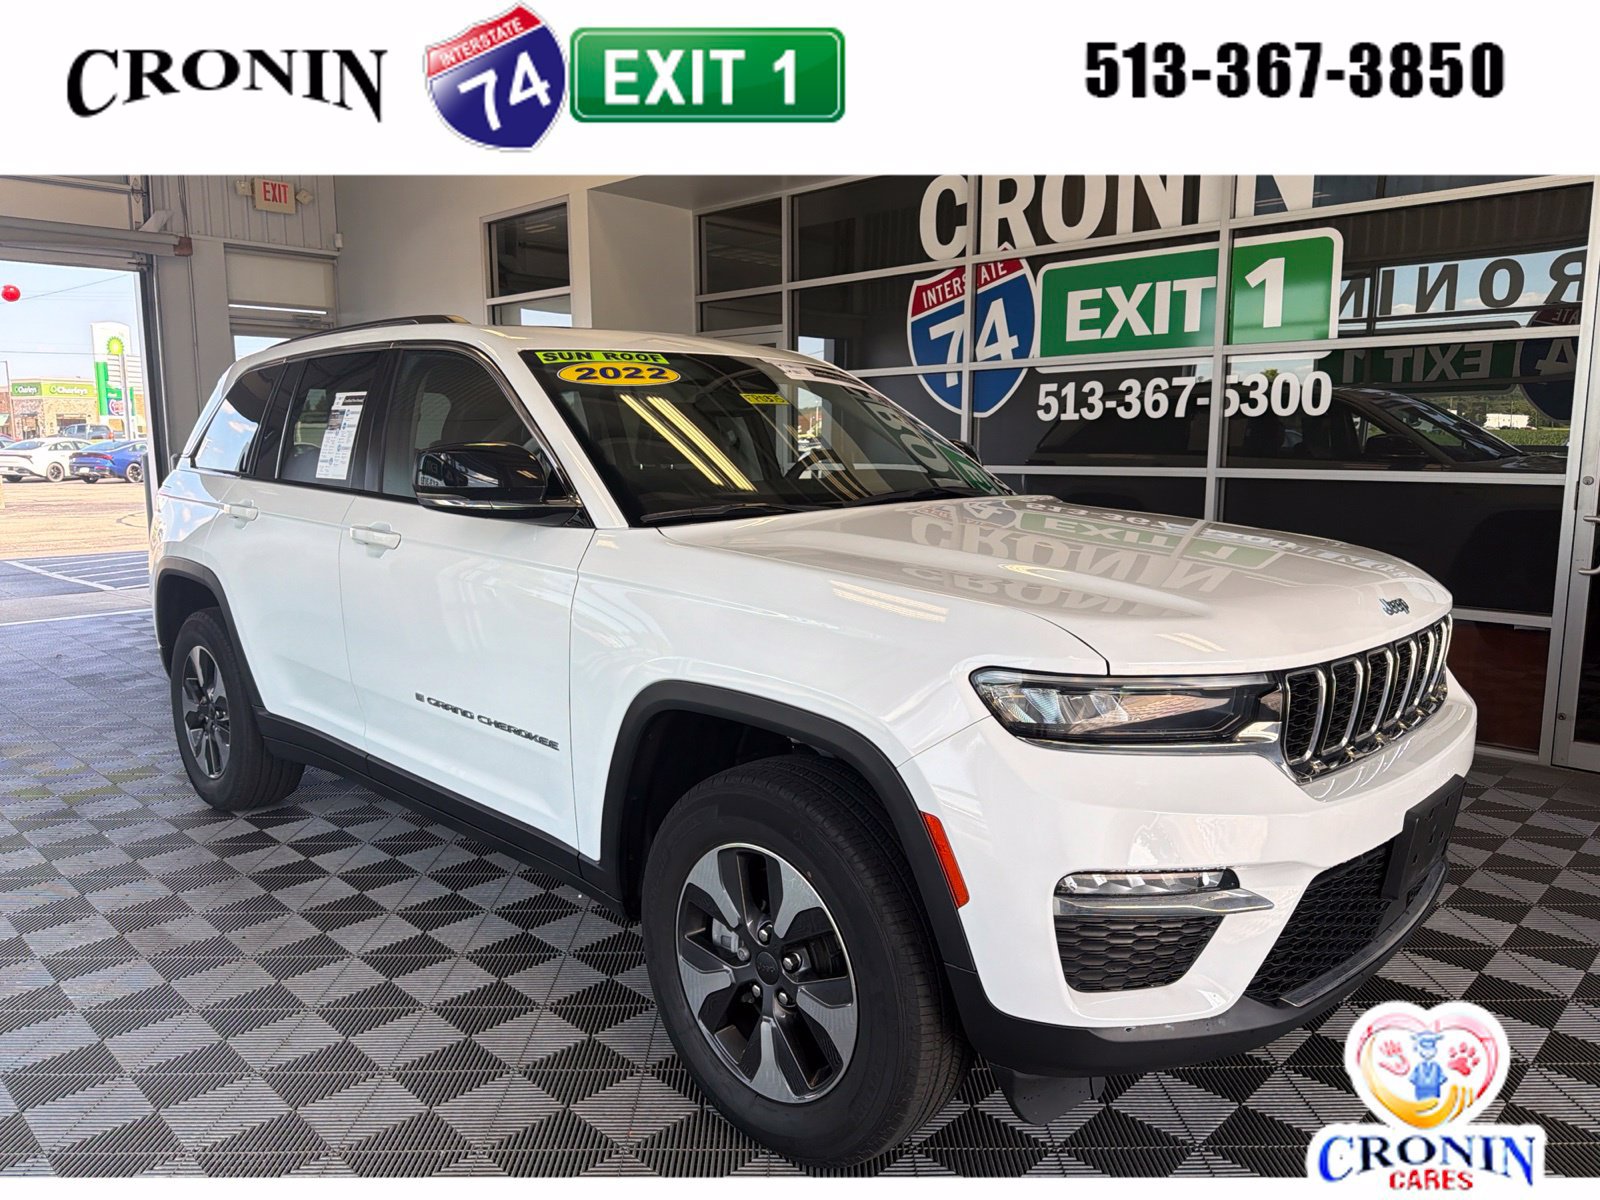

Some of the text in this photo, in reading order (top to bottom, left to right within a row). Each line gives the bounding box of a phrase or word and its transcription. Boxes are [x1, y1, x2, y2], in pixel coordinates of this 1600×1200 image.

[262, 181, 288, 204] EXIT
[919, 175, 1313, 261] CRONIN
[1066, 257, 1285, 342] EXIT 1
[543, 352, 661, 363] SUN ROOF
[929, 298, 1020, 388] 74
[575, 366, 668, 381] 2022
[426, 697, 559, 751] GRAND CHEROKEE
